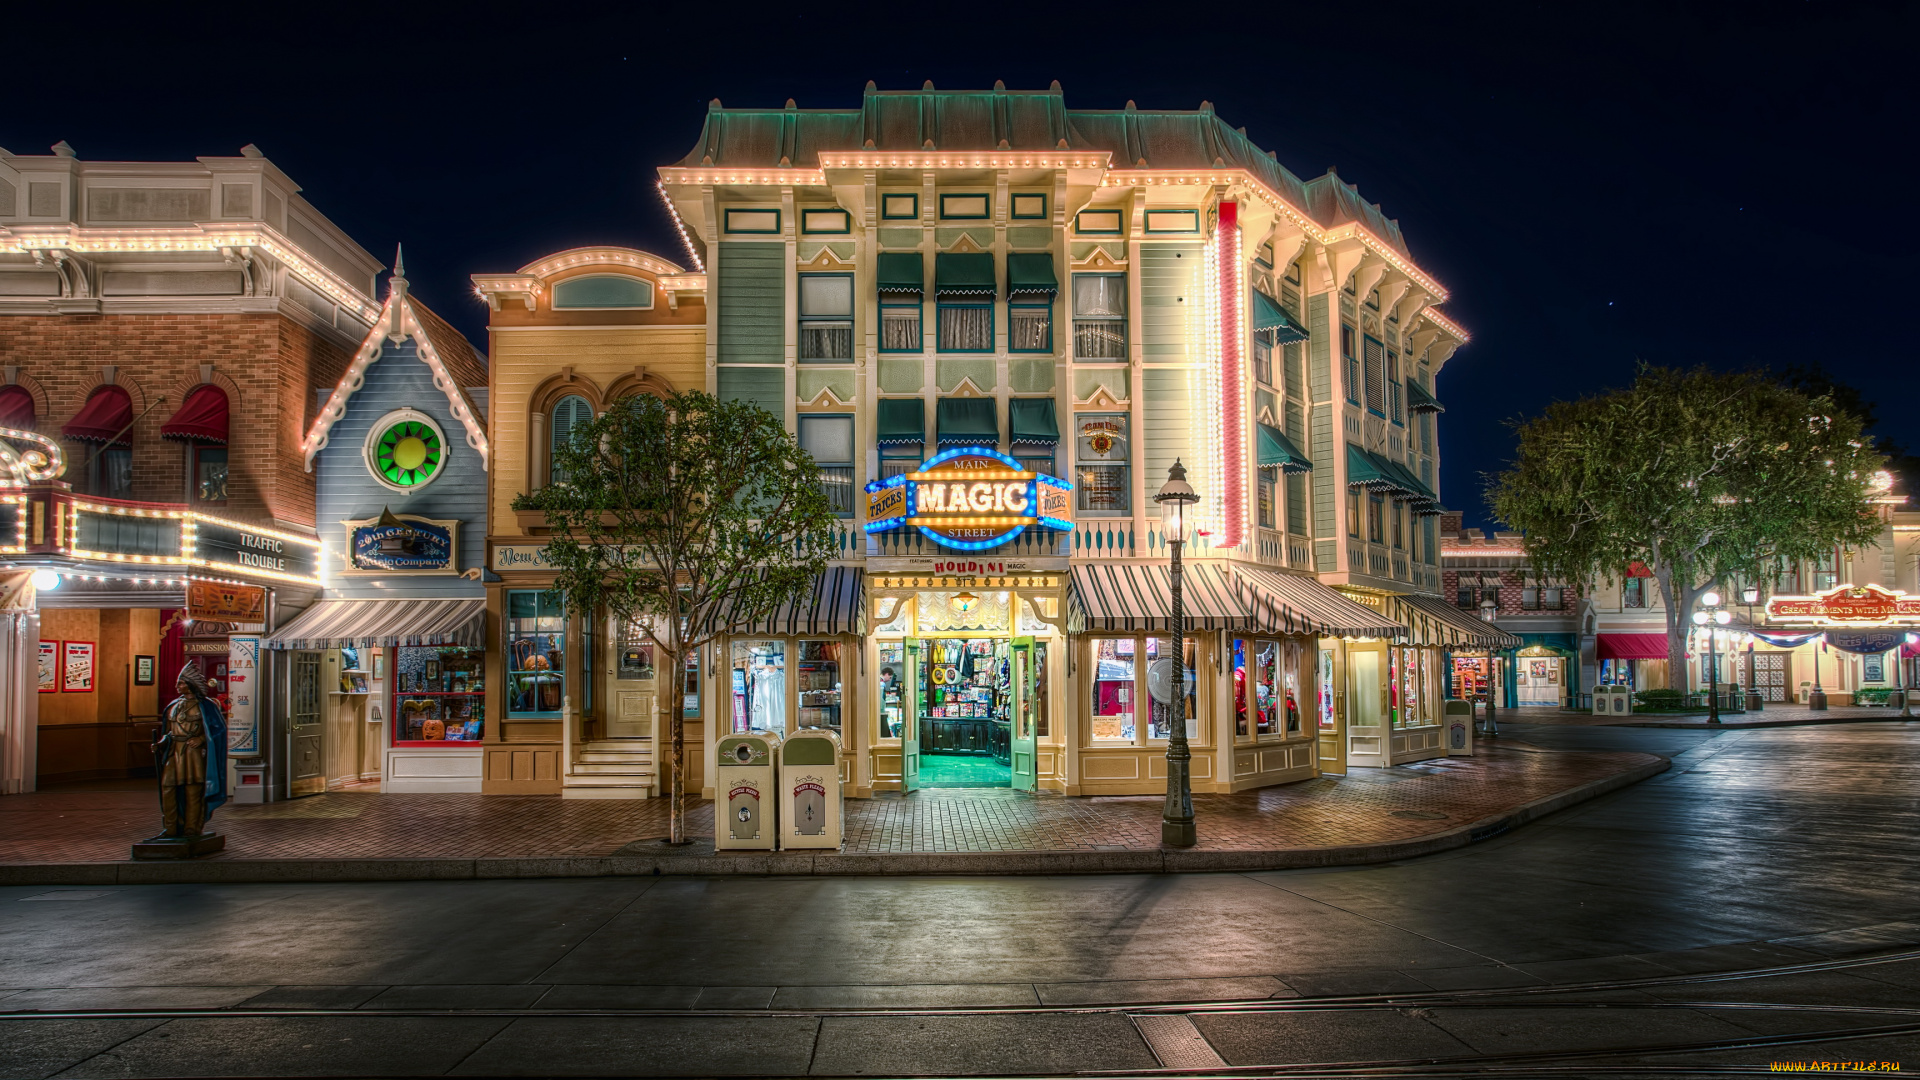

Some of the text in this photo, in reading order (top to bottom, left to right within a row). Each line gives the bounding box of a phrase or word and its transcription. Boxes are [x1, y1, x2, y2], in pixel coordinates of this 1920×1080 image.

[954, 460, 988, 469] MAIN
[869, 491, 902, 517] TRICKS
[916, 482, 1029, 513] MAGIC
[1044, 495, 1066, 511] JOKES
[948, 528, 996, 538] STREET
[240, 533, 283, 554] TRAFFIC
[237, 550, 285, 571] TROUBLE
[394, 557, 448, 567] Company
[498, 547, 532, 566] New
[934, 561, 1004, 575] HOUDINI
[1780, 605, 1809, 614] GREAT
[1810, 605, 1853, 614] MOMENTS
[1855, 606, 1879, 614] WITH
[190, 644, 230, 652] ADMISSION
